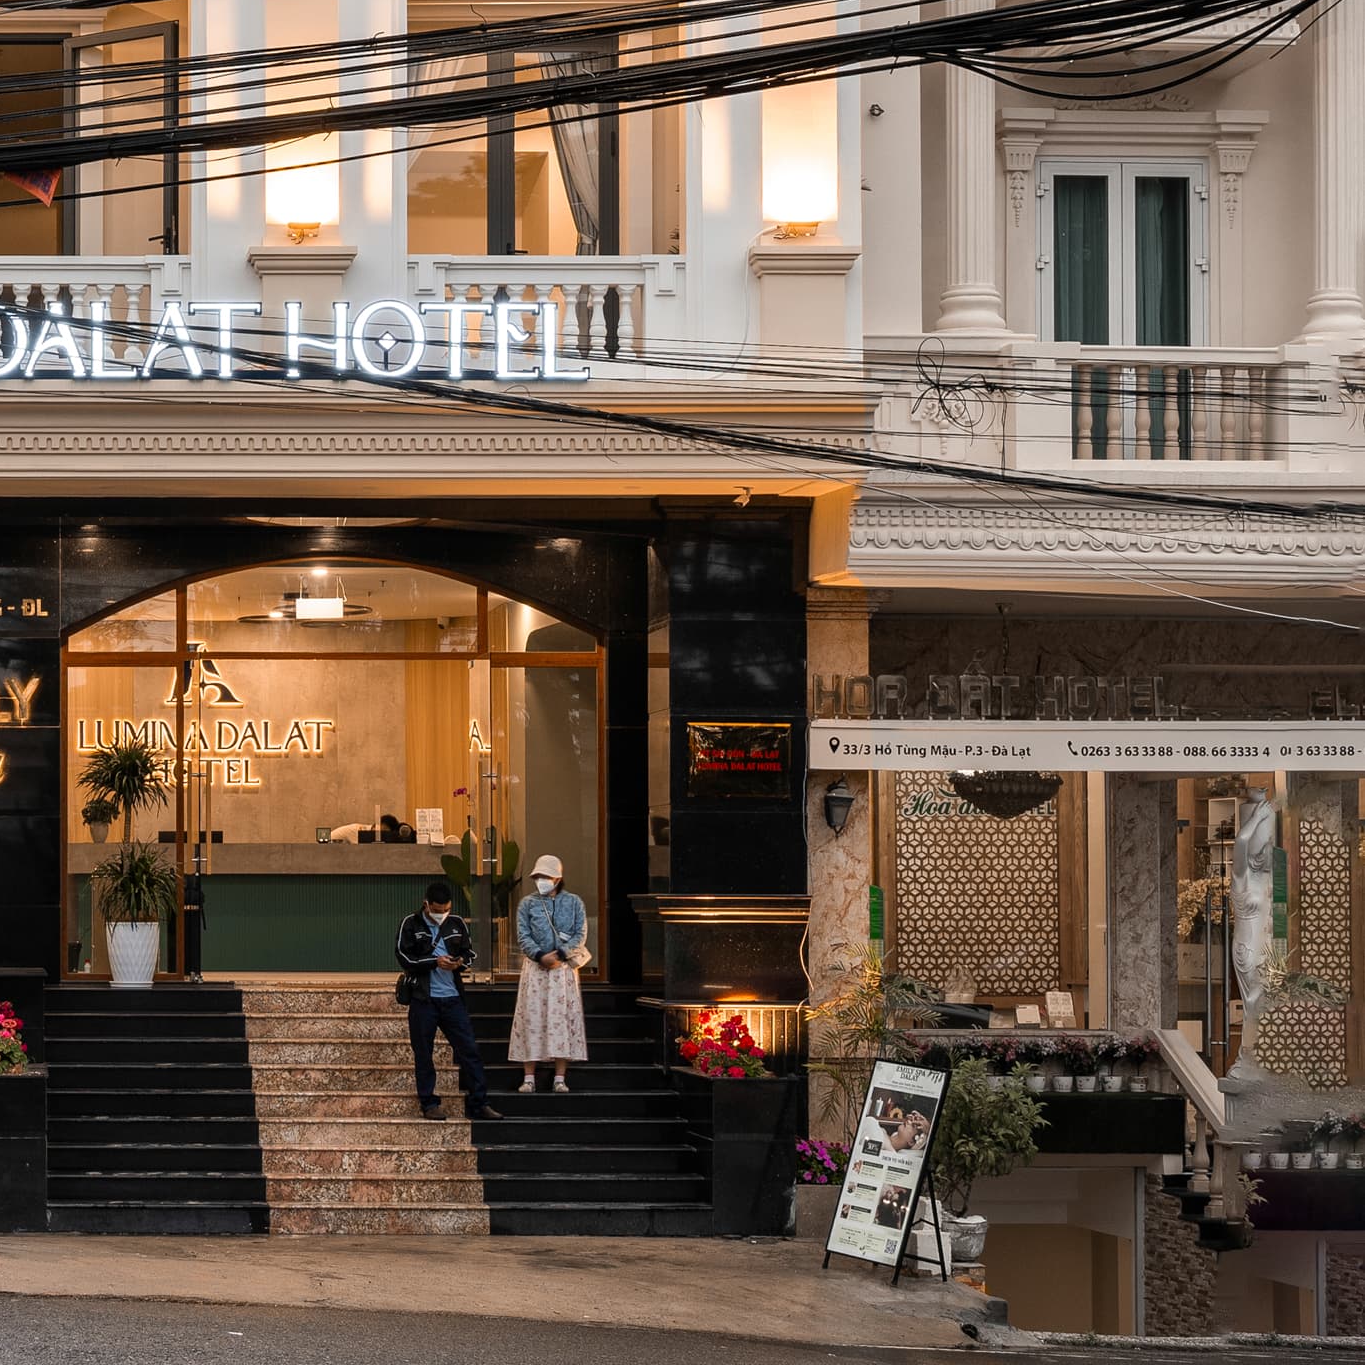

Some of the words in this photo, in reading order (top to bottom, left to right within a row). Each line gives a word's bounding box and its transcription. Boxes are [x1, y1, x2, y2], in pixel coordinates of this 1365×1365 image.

[284, 300, 591, 379] HOTEL
[813, 674, 908, 716] HOA
[1035, 676, 1180, 717] HOTEL
[77, 719, 209, 751] LUMINA
[216, 719, 333, 751] DALAT
[843, 744, 871, 756] 33/3
[896, 744, 926, 758] Tùng
[965, 745, 983, 756] P.3
[1011, 746, 1031, 759] Lạt
[1081, 746, 1111, 757] 0263
[1212, 746, 1227, 757] 66
[1230, 746, 1259, 757] 3333
[903, 790, 951, 817] Hoa
